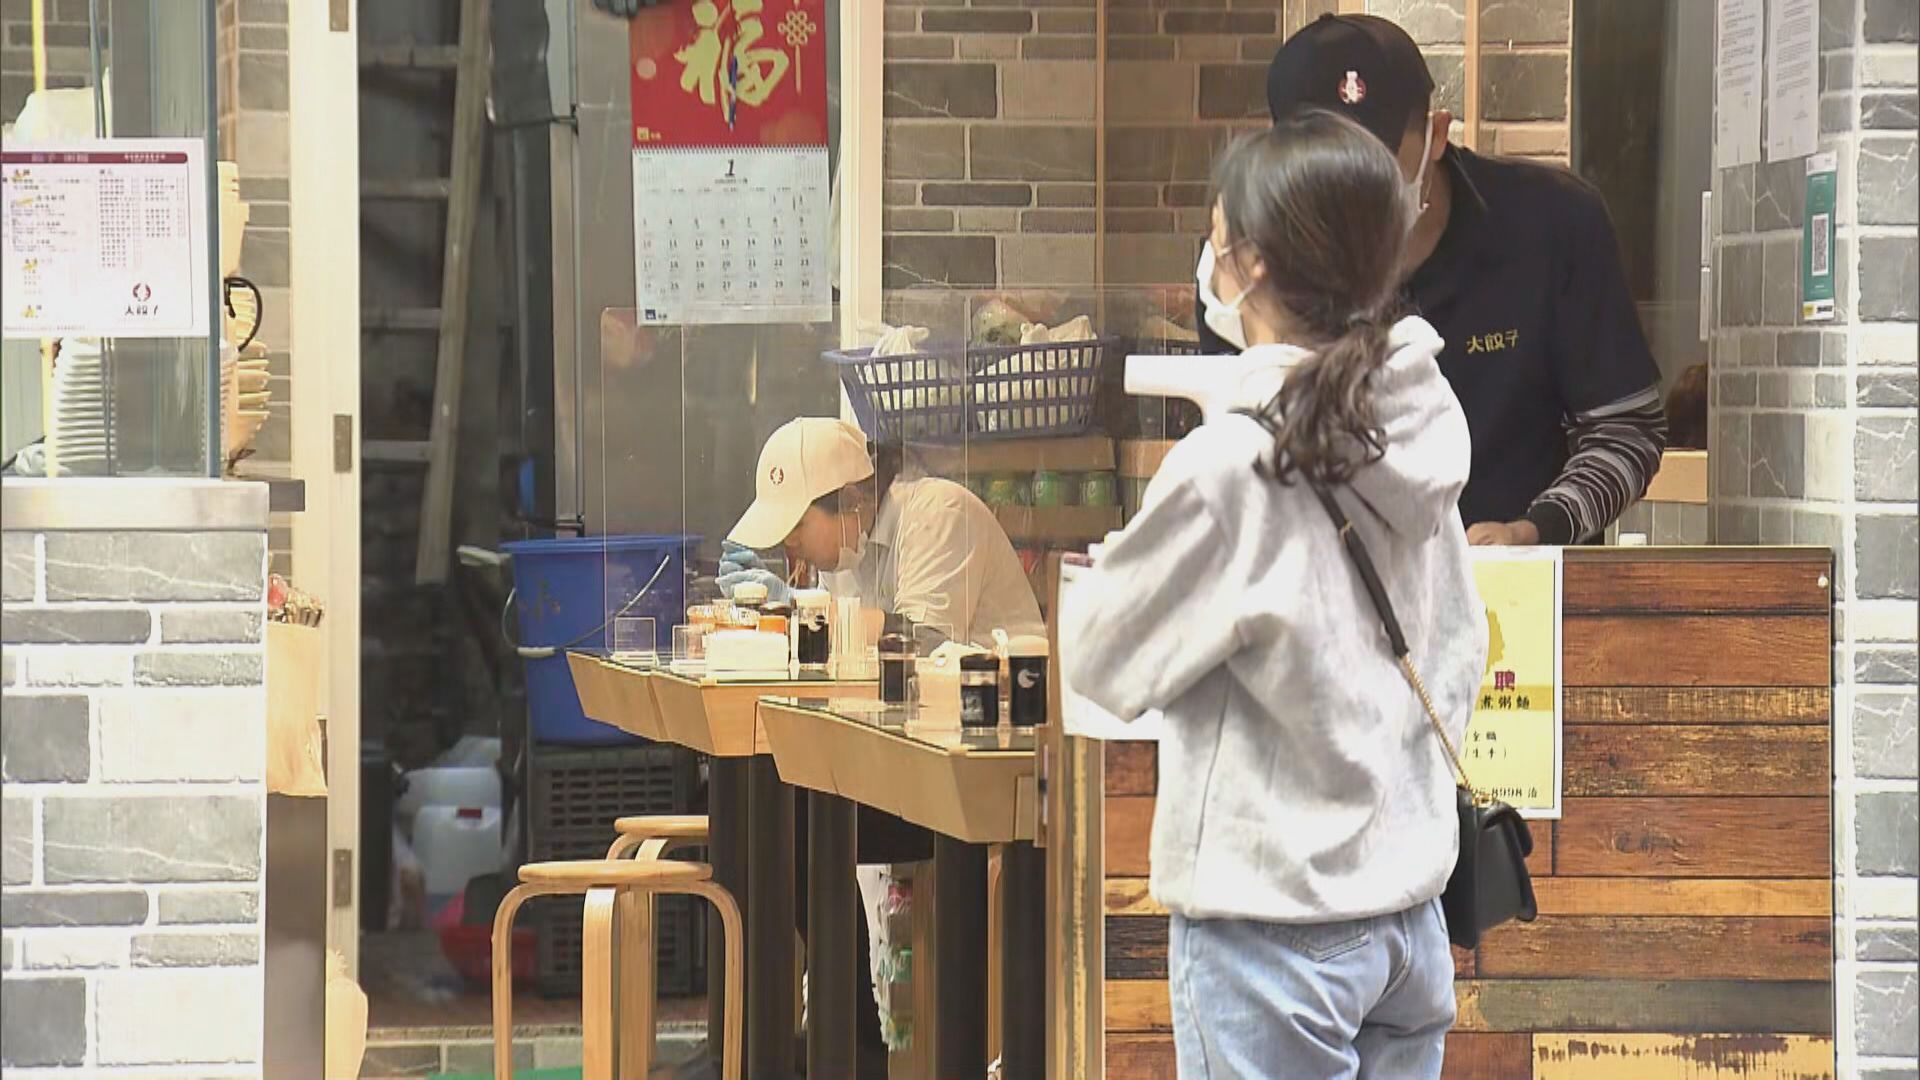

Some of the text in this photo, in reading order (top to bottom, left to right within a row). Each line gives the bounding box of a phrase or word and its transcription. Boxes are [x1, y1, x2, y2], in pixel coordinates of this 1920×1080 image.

[674, 0, 789, 124] 福
[725, 159, 735, 177] 1
[1466, 328, 1518, 354] 大餃子
[1494, 669, 1516, 692] 聘
